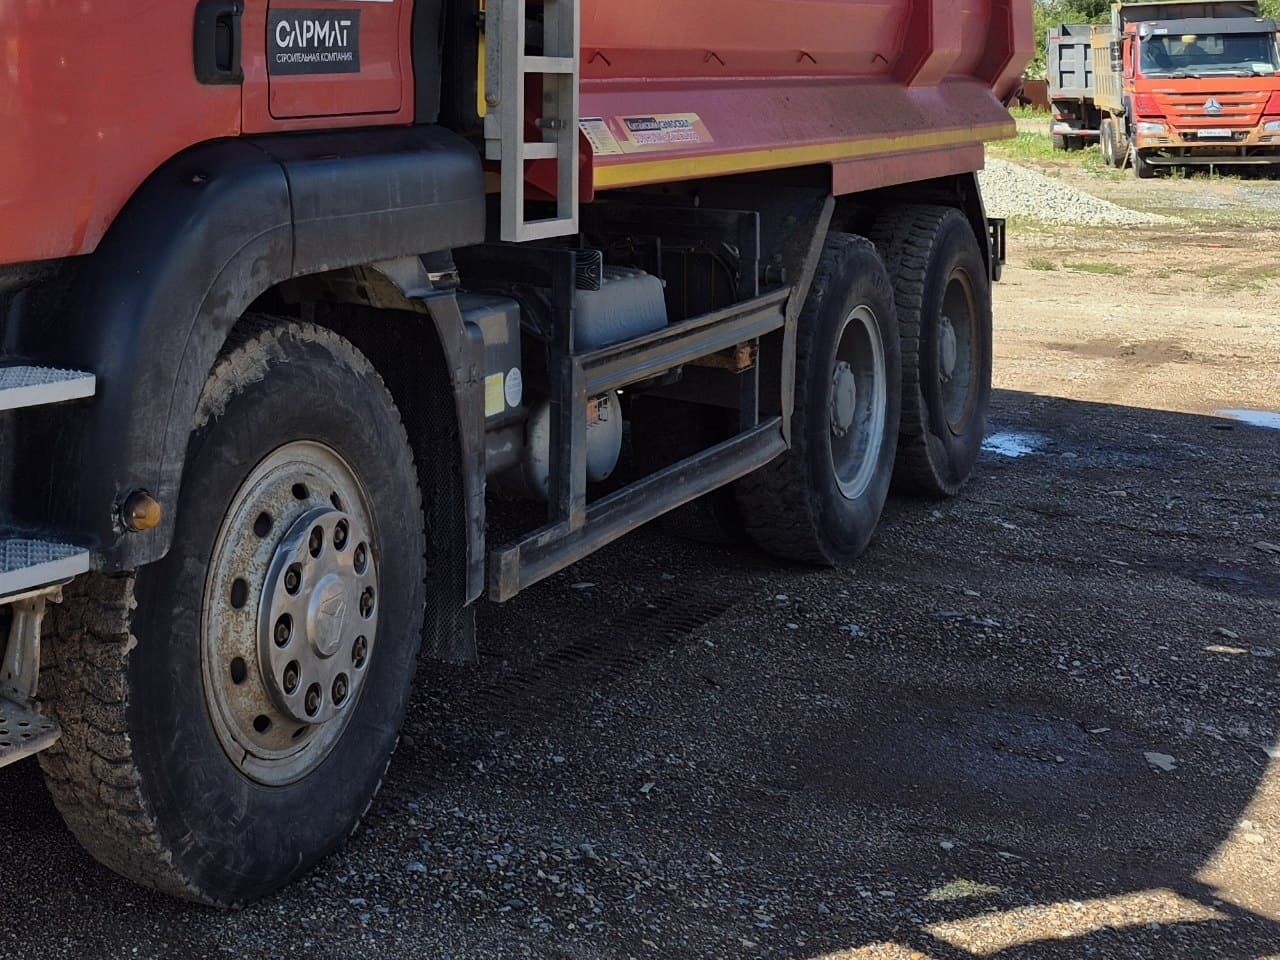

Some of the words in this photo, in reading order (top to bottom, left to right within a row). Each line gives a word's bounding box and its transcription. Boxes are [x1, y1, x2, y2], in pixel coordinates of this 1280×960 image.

[275, 20, 351, 48] САРМАТ
[275, 53, 320, 63] СТРОИТЕЛЬНАЯ
[321, 52, 353, 62] КОМПАНИЯ
